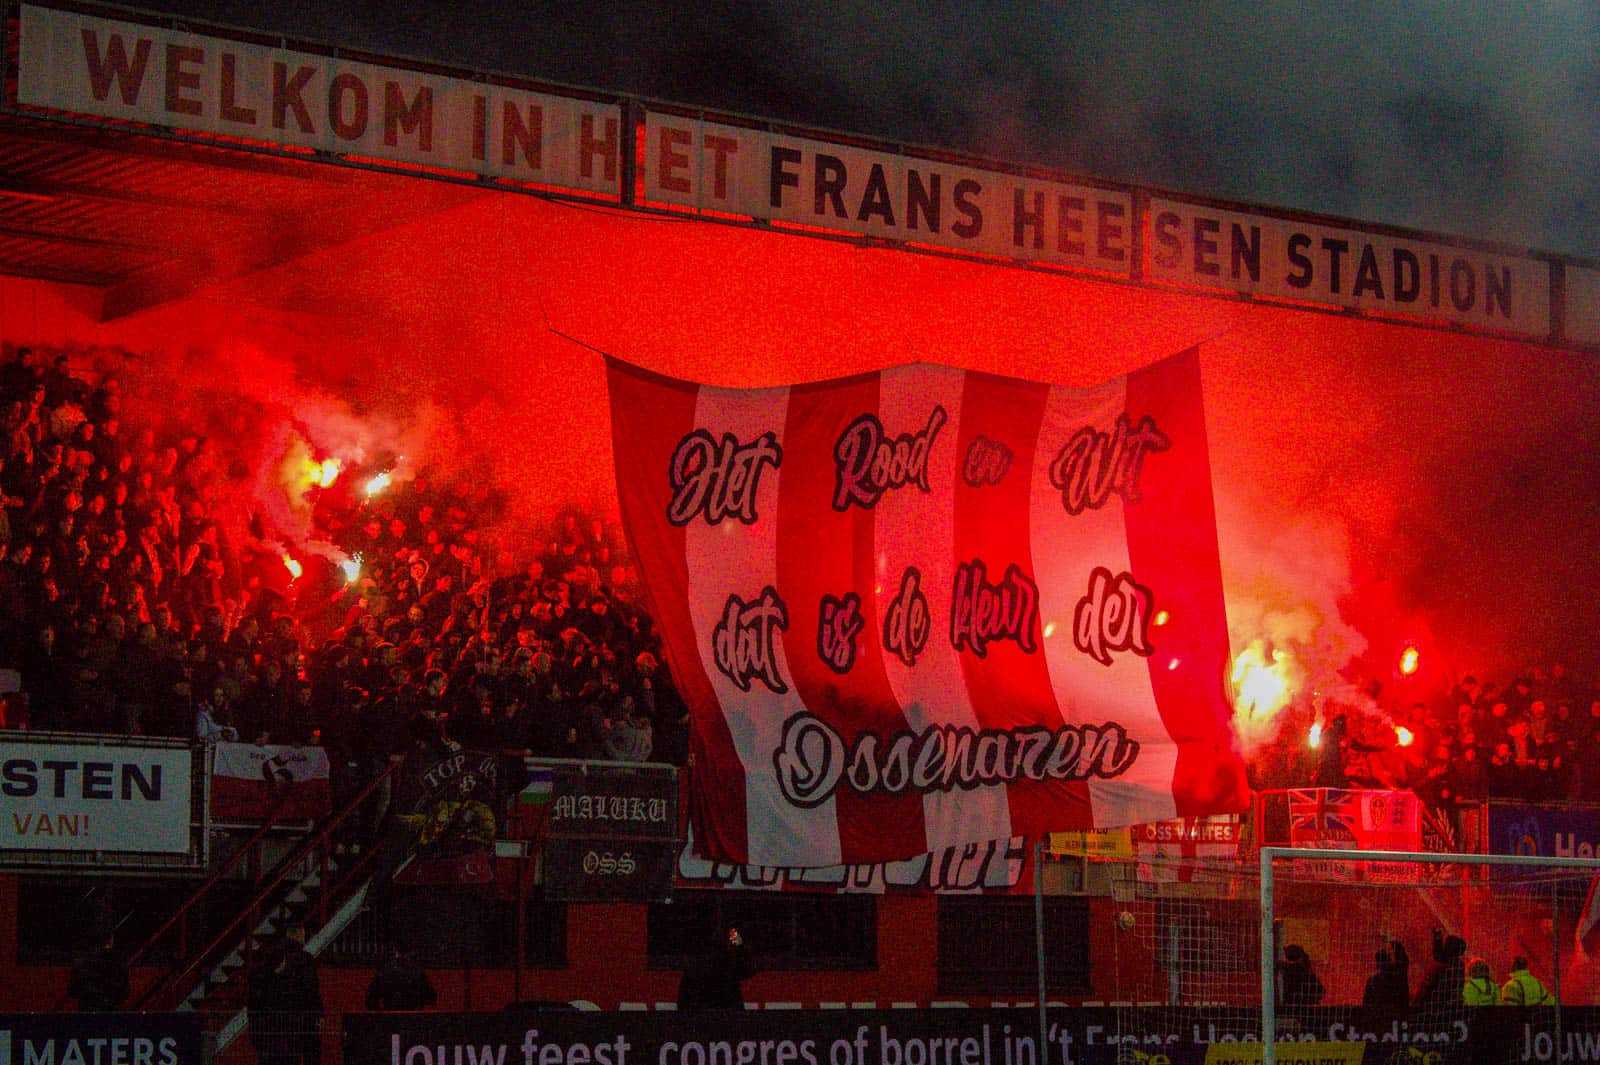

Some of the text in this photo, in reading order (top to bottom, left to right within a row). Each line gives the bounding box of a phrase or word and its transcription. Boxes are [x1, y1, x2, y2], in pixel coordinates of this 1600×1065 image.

[80, 28, 1513, 320] WELKOM IN HET FRANS HEESEN STADION
[668, 428, 782, 527] Het
[832, 404, 948, 512] Rood
[1049, 412, 1171, 516] Wit
[712, 585, 790, 694] dat
[816, 592, 864, 674] is
[883, 565, 931, 667] de
[776, 711, 1139, 809] Ossenaren
[12, 813, 90, 837] VAN!
[552, 796, 668, 823] MALUKU
[1146, 826, 1172, 842] OSS
[582, 850, 636, 875] OSS
[830, 1025, 868, 1065] of
[880, 1024, 990, 1065] borrel
[1003, 1024, 1035, 1065] in
